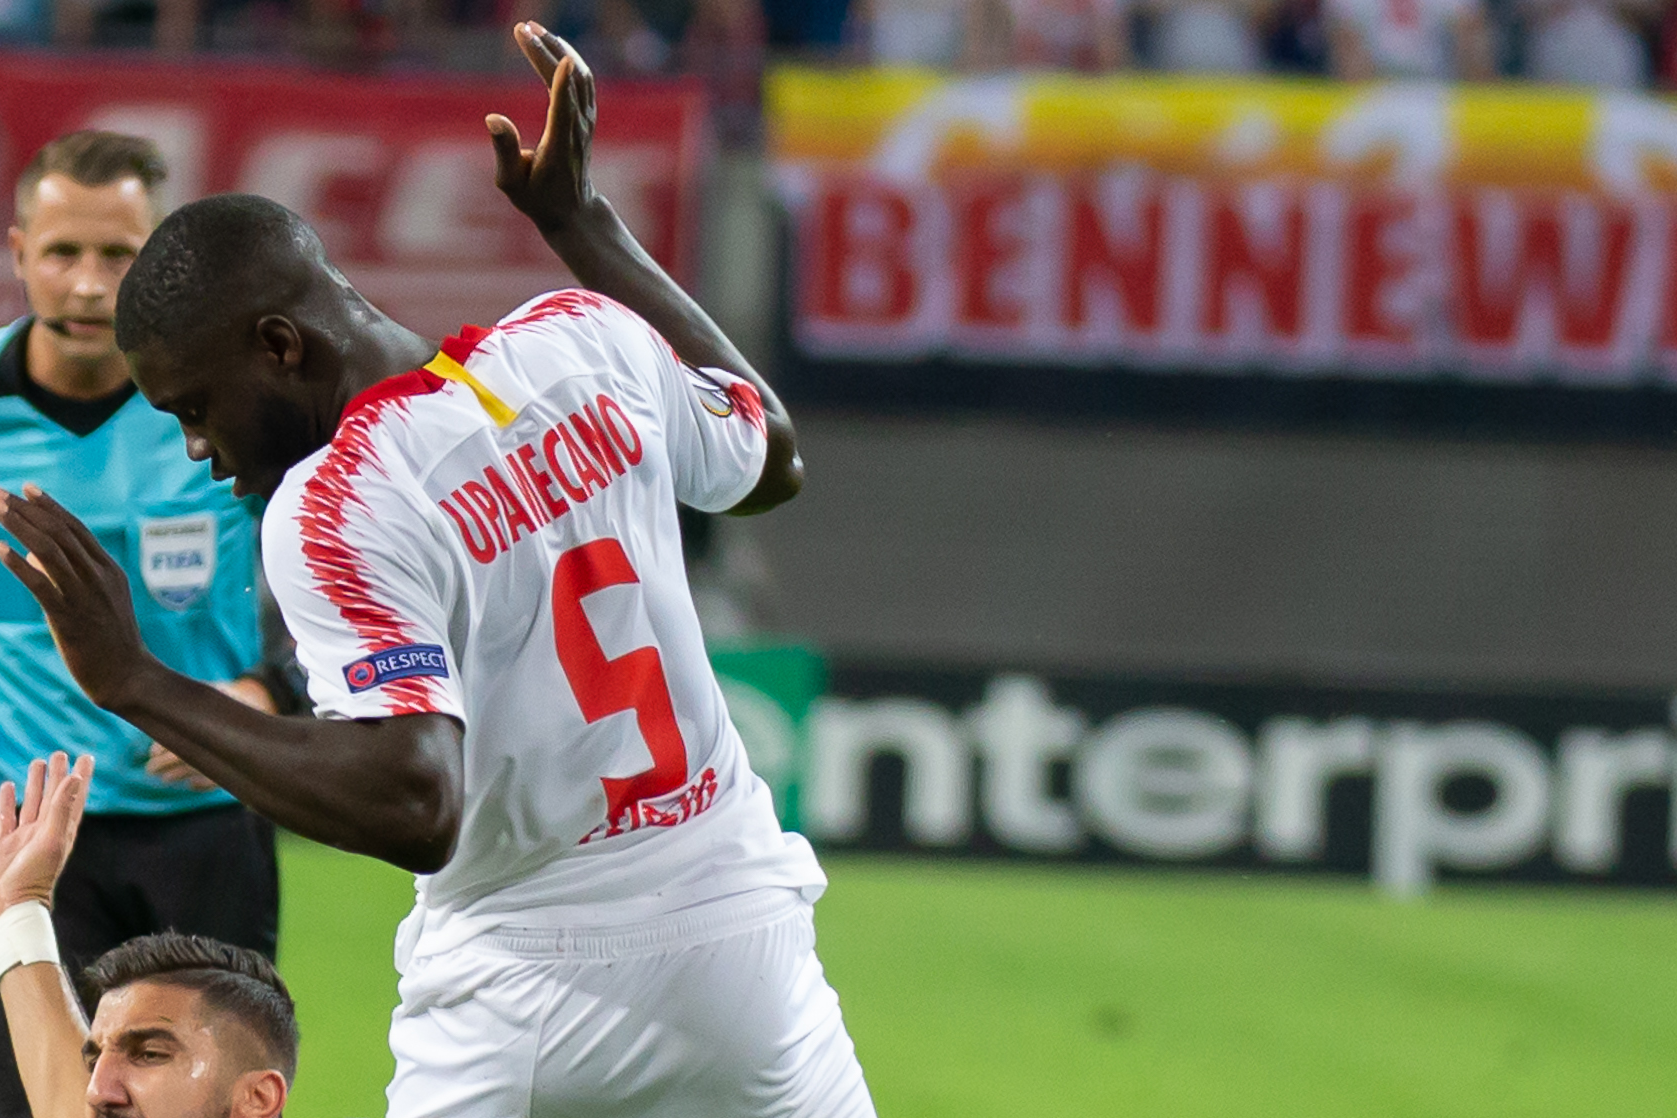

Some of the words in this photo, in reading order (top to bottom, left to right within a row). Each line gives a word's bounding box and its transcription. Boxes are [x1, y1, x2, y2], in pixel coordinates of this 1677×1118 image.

[798, 178, 1677, 350] BENNEW
[375, 652, 445, 674] RESPECT
[551, 537, 688, 828] 5
